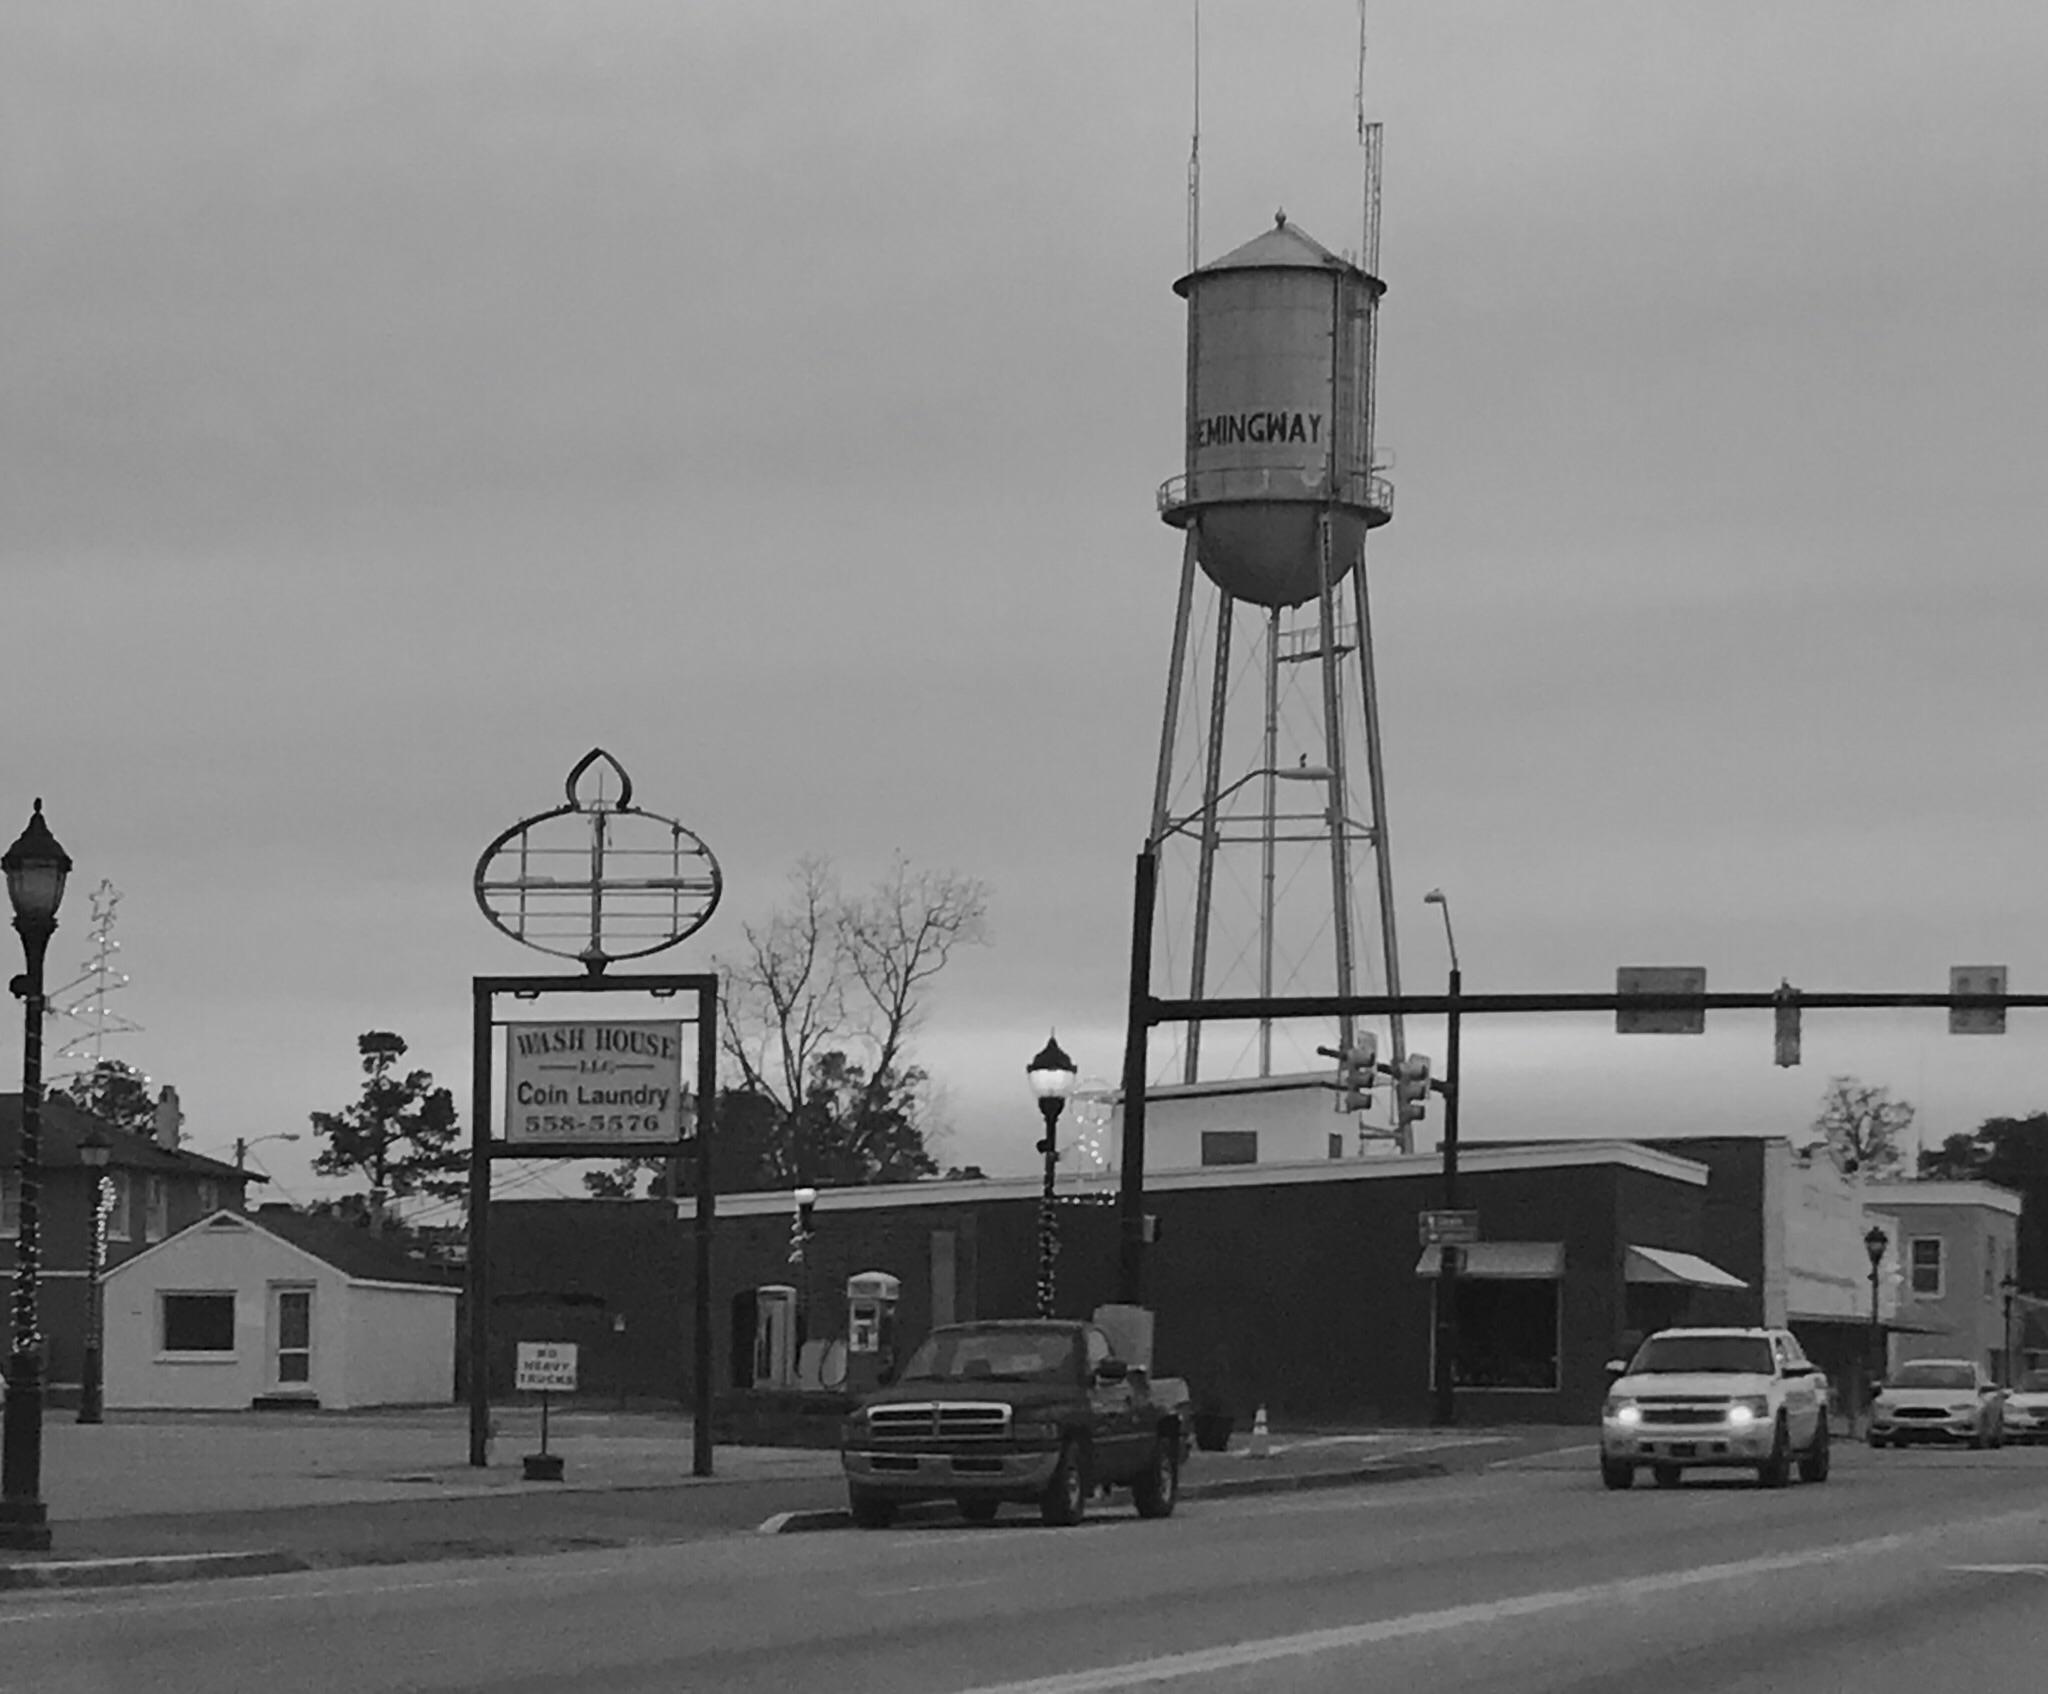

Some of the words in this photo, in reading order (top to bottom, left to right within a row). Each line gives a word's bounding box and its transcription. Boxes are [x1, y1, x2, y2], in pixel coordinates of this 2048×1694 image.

[516, 1027, 585, 1057] WASH
[597, 1027, 677, 1060] HOUSE
[517, 1080, 568, 1106] Coin
[577, 1084, 670, 1112] Laundry
